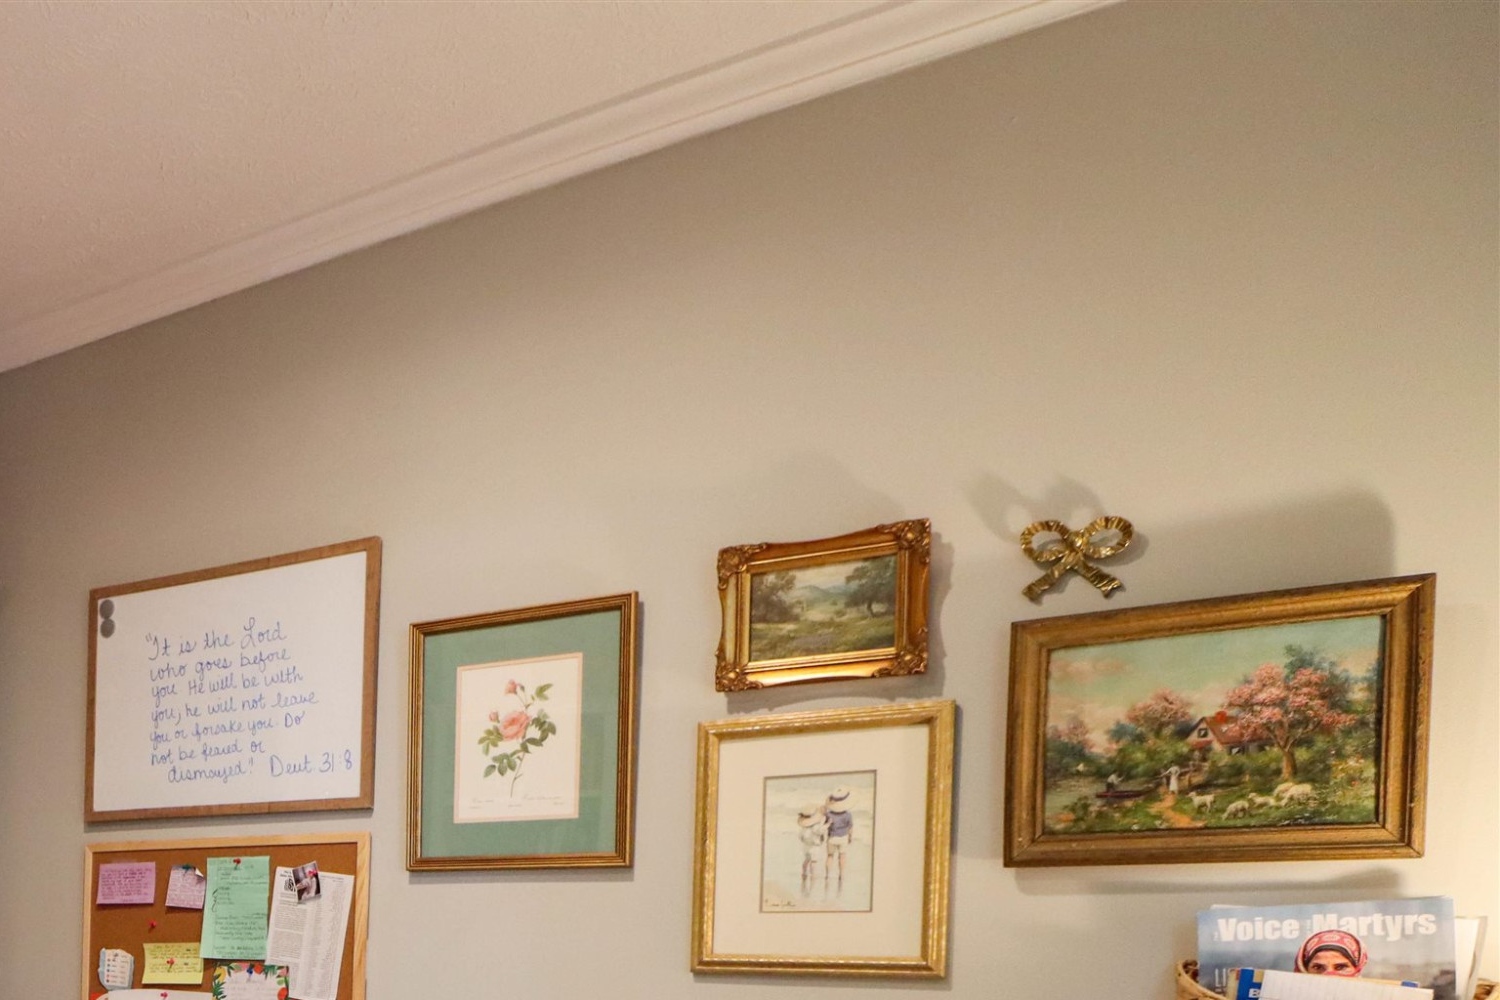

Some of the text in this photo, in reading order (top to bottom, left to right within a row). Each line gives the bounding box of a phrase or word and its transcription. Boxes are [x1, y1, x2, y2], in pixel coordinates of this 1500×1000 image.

[179, 636, 197, 655] is
[203, 630, 234, 650] the
[240, 616, 287, 650] Lord
[150, 648, 290, 682] who goes before
[188, 679, 205, 696] He
[208, 672, 237, 693] will
[241, 673, 260, 689] be
[264, 666, 303, 686] with
[185, 704, 201, 718] he
[207, 698, 236, 714] will
[241, 695, 265, 711] not
[271, 691, 319, 709] leave
[150, 728, 171, 750] you
[174, 728, 188, 739] or
[191, 719, 245, 738] forsake
[284, 711, 305, 728] Do
[150, 750, 174, 766] not
[178, 745, 197, 761] be
[250, 740, 267, 754] or
[1217, 912, 1437, 942] Voice Martyrs
